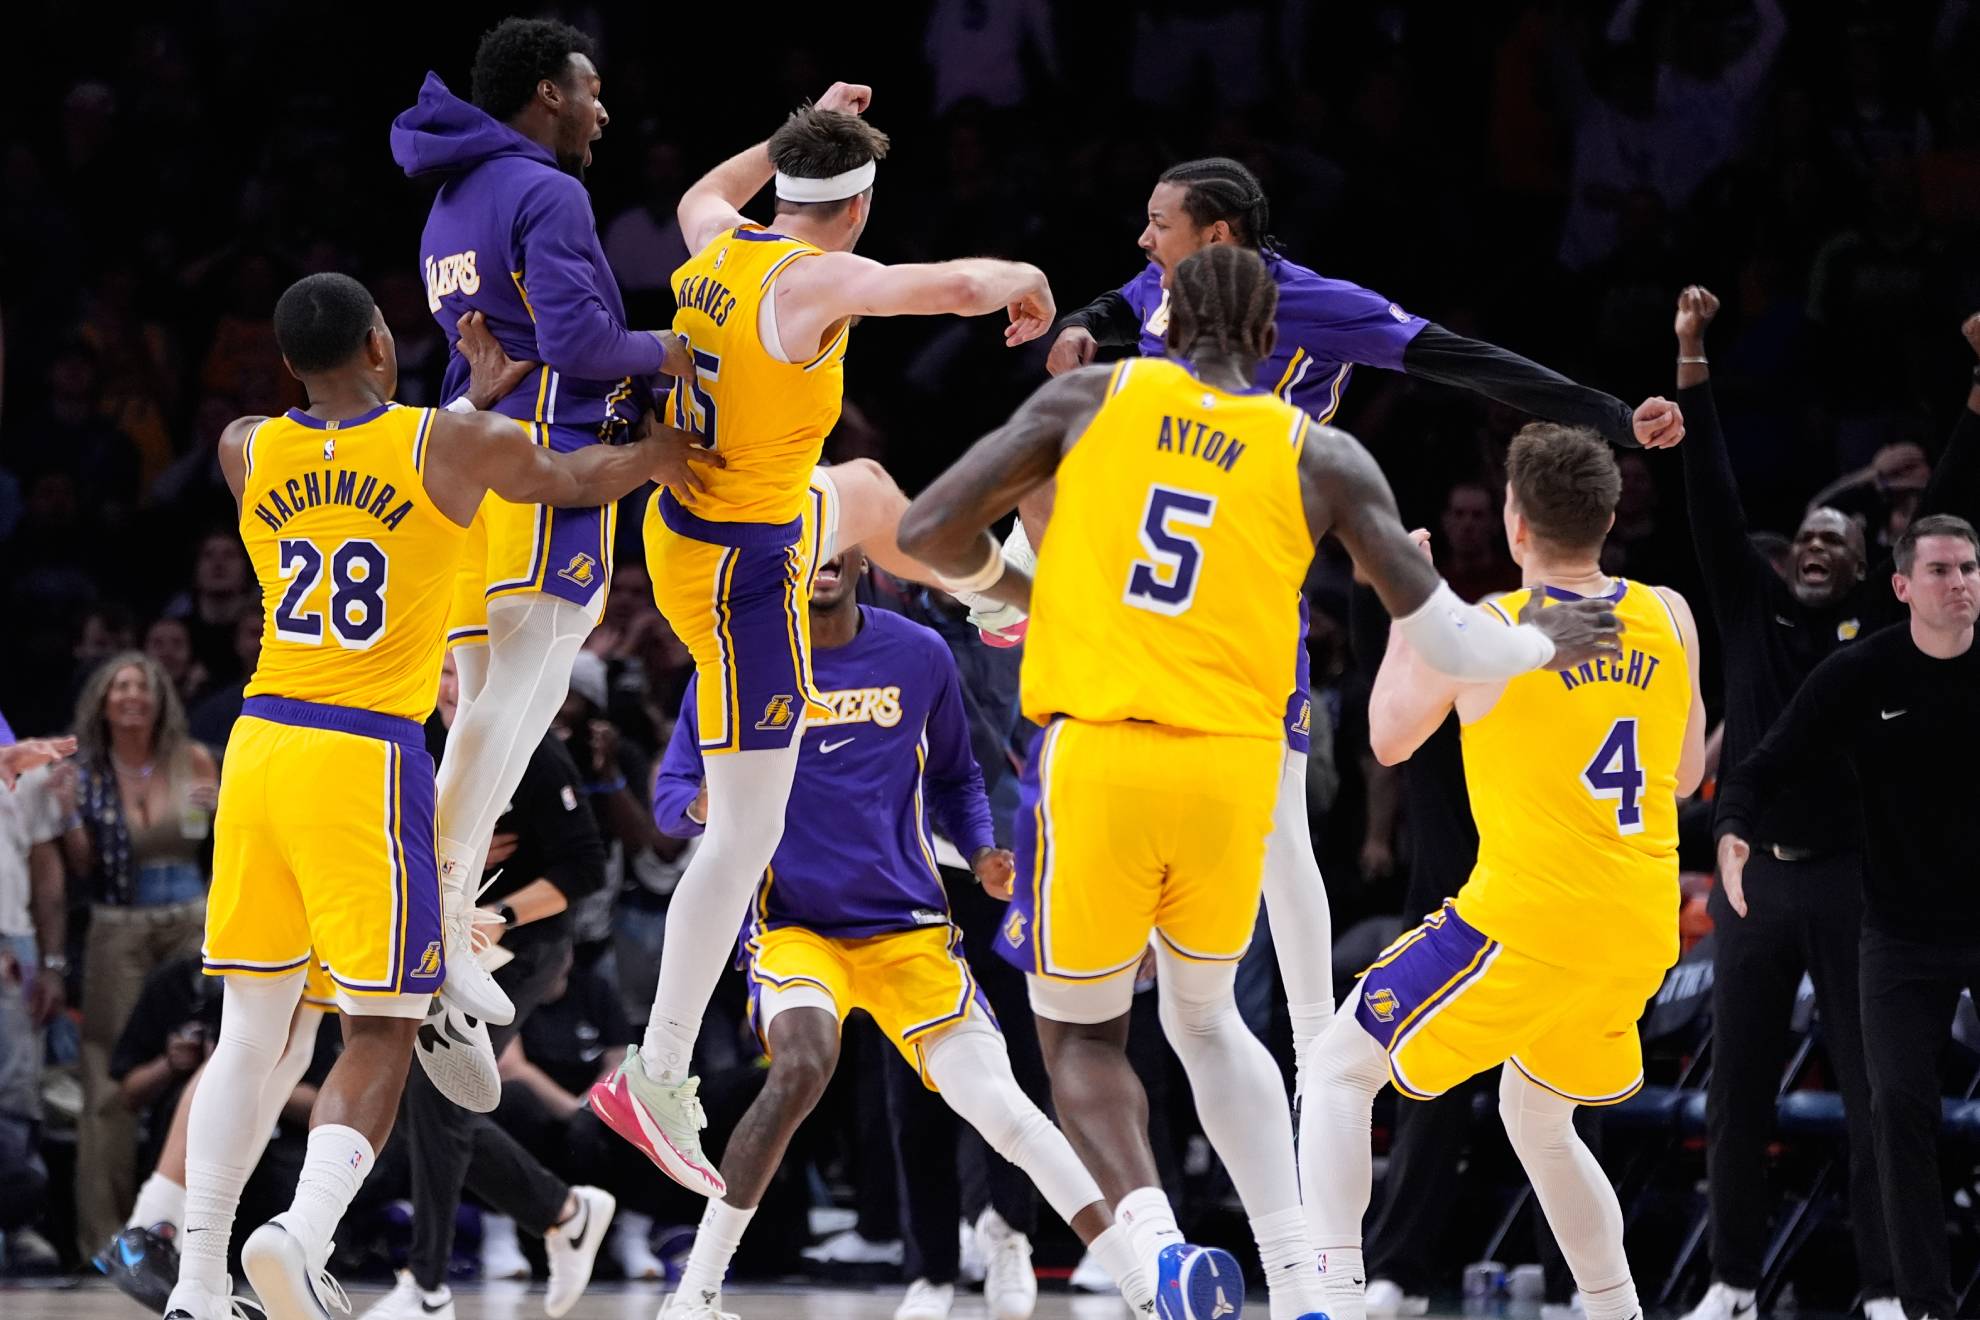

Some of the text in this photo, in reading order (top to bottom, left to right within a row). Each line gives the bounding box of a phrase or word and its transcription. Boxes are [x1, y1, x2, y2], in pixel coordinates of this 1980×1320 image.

[425, 249, 480, 315] LAKERS
[678, 275, 736, 327] REAVES
[674, 333, 721, 451] 15
[1157, 415, 1246, 473] AYTON
[254, 469, 414, 533] HACHIMURA
[1122, 483, 1219, 617] 5
[275, 537, 388, 651] 28
[804, 686, 903, 728] KERS
[1579, 716, 1646, 836] 4
